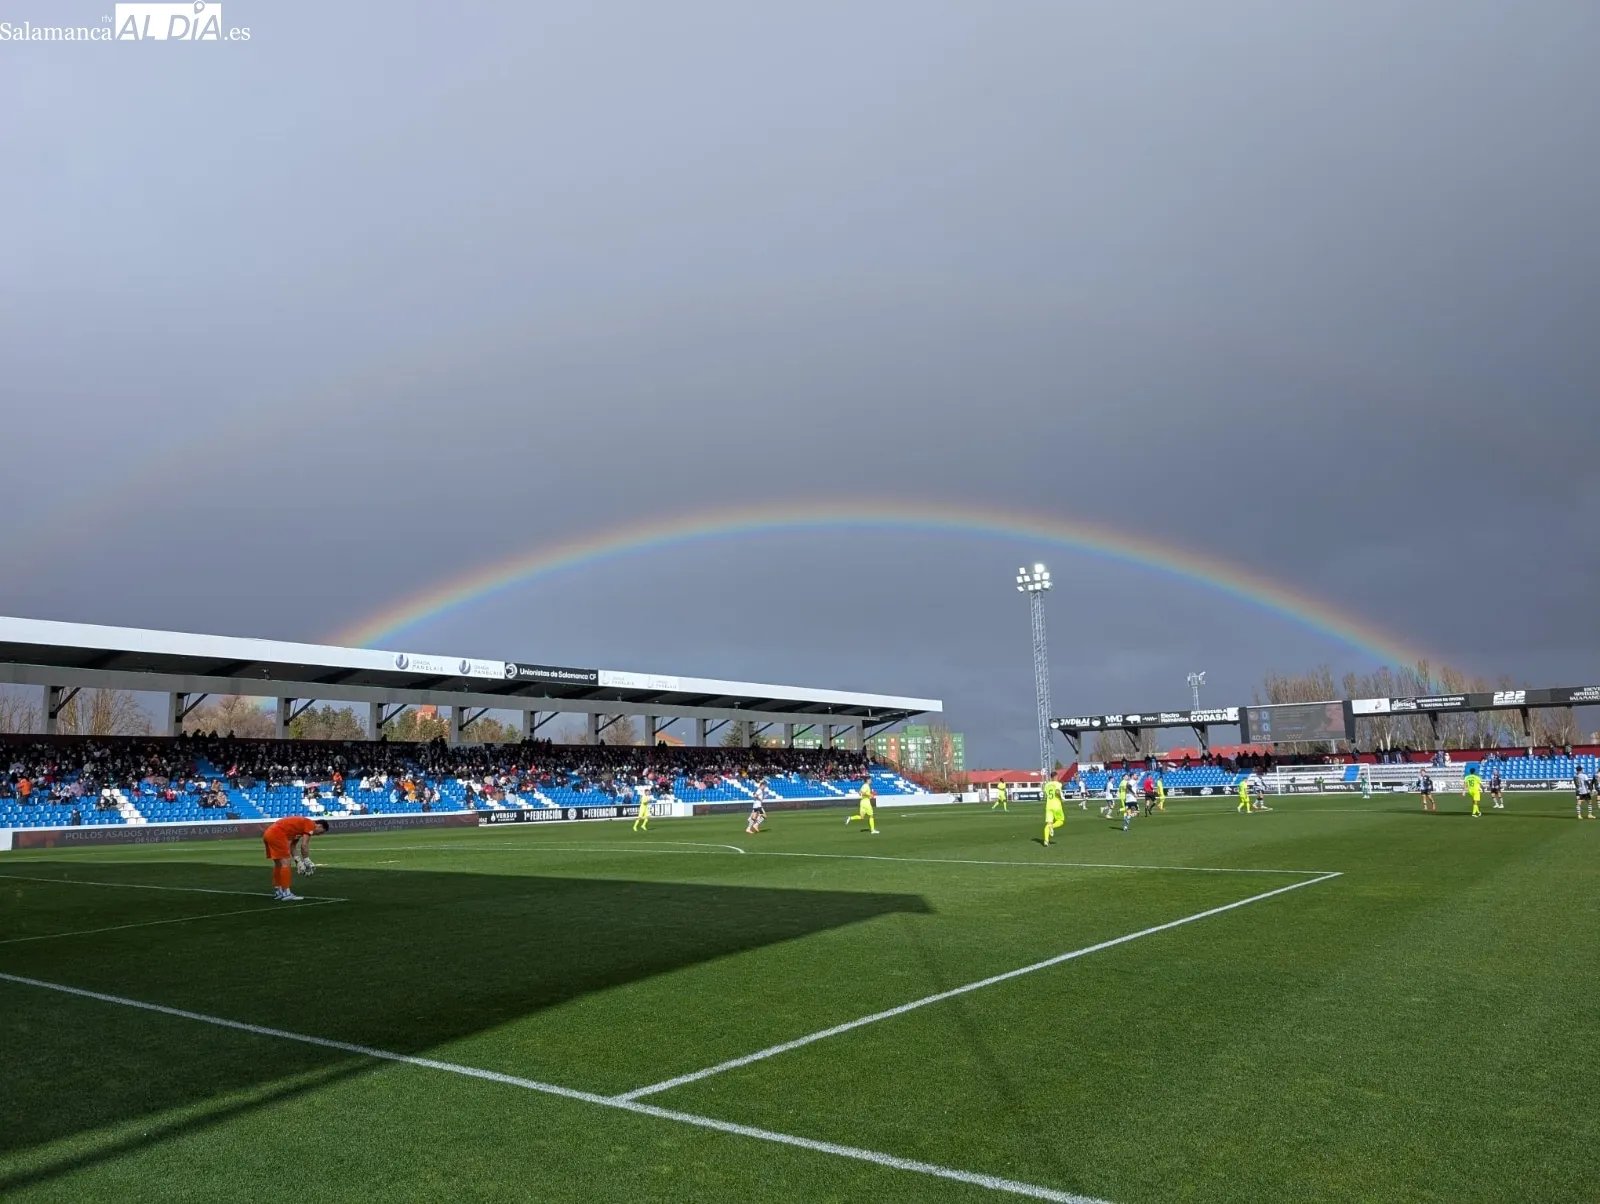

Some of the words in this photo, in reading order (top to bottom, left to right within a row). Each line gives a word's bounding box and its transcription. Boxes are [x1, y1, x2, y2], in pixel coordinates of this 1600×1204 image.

[520, 667, 549, 677] Unionistas
[559, 671, 588, 680] Salamanca
[1494, 690, 1525, 700] 222
[1191, 713, 1228, 722] CODASA
[530, 808, 562, 821] FEDERACIÓN
[350, 820, 376, 828] ASADOS
[384, 818, 408, 826] CARNES
[65, 831, 103, 840] POLLOS
[105, 829, 142, 839] ASADOS
[153, 828, 188, 836] CARNES
[211, 826, 239, 834] BRASA
